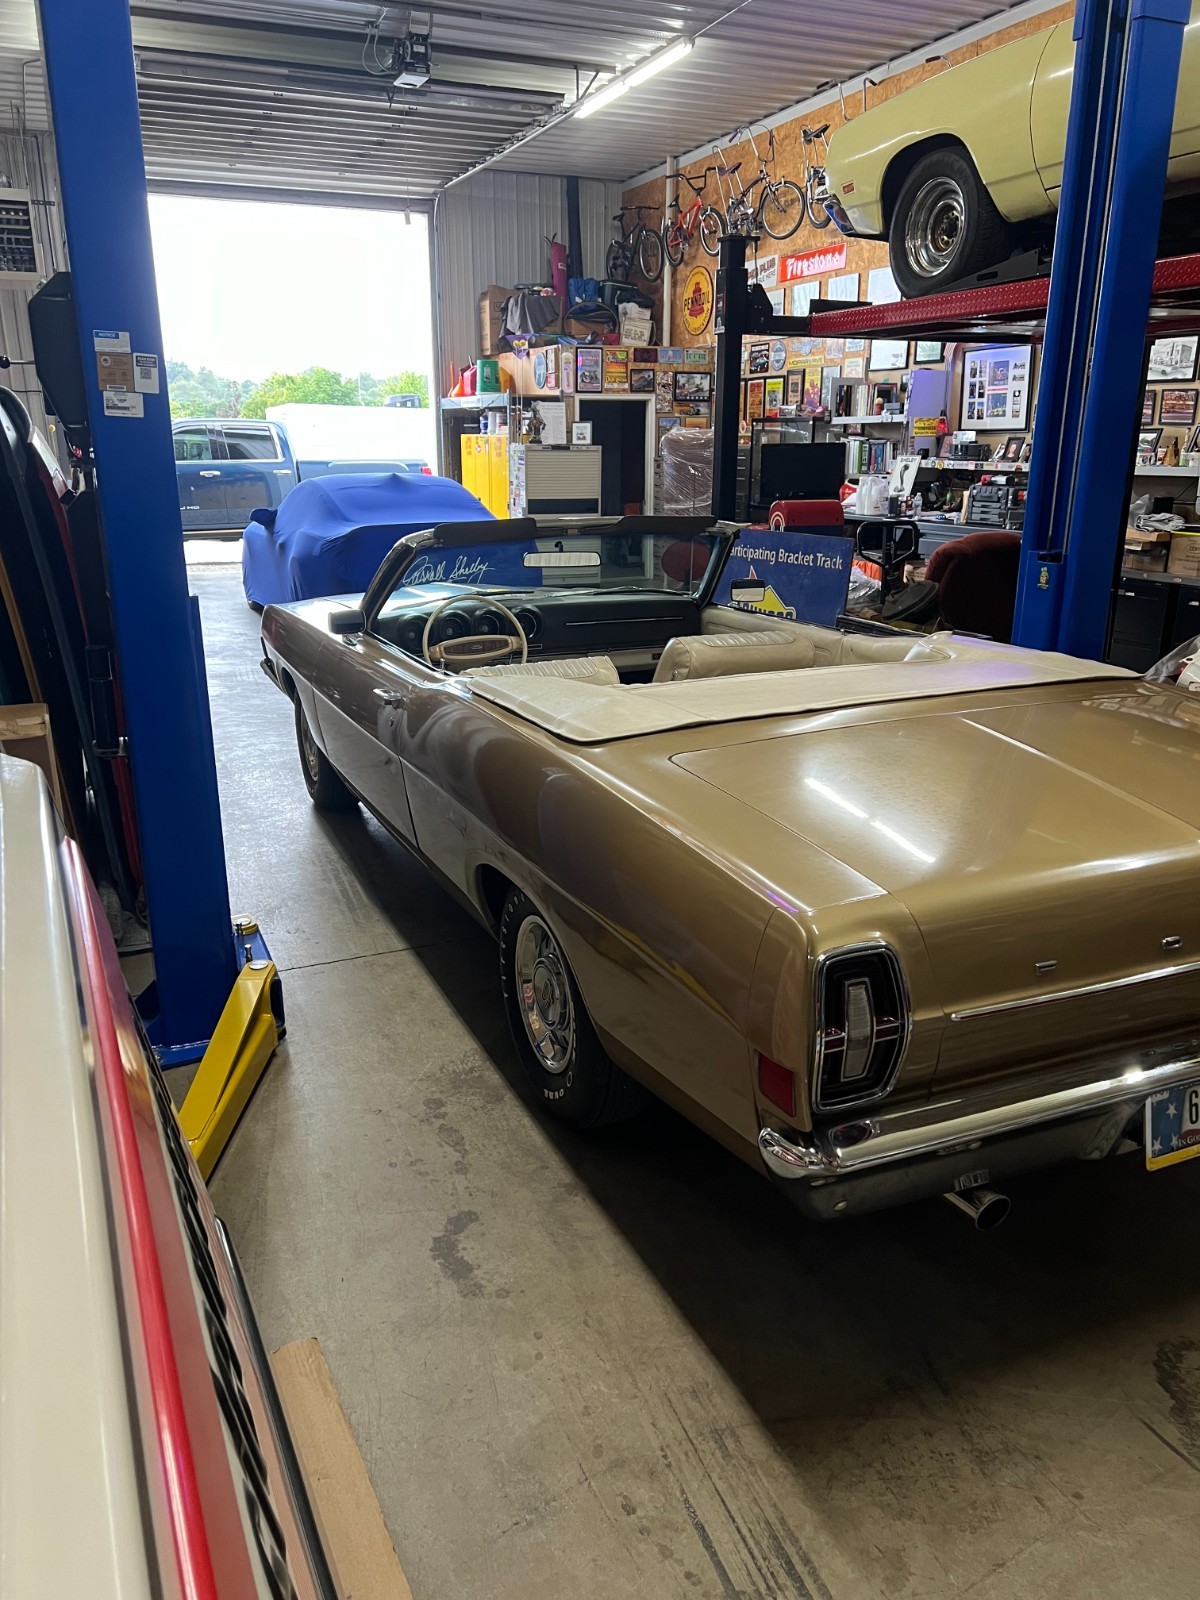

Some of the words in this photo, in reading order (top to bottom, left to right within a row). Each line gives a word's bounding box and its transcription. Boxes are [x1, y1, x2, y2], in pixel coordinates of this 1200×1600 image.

[785, 251, 839, 280] Firestone
[683, 289, 710, 313] PENNZOIL
[448, 555, 496, 585] Shelby
[730, 544, 777, 565] articipating
[778, 548, 814, 567] Bracket
[816, 552, 843, 570] Track
